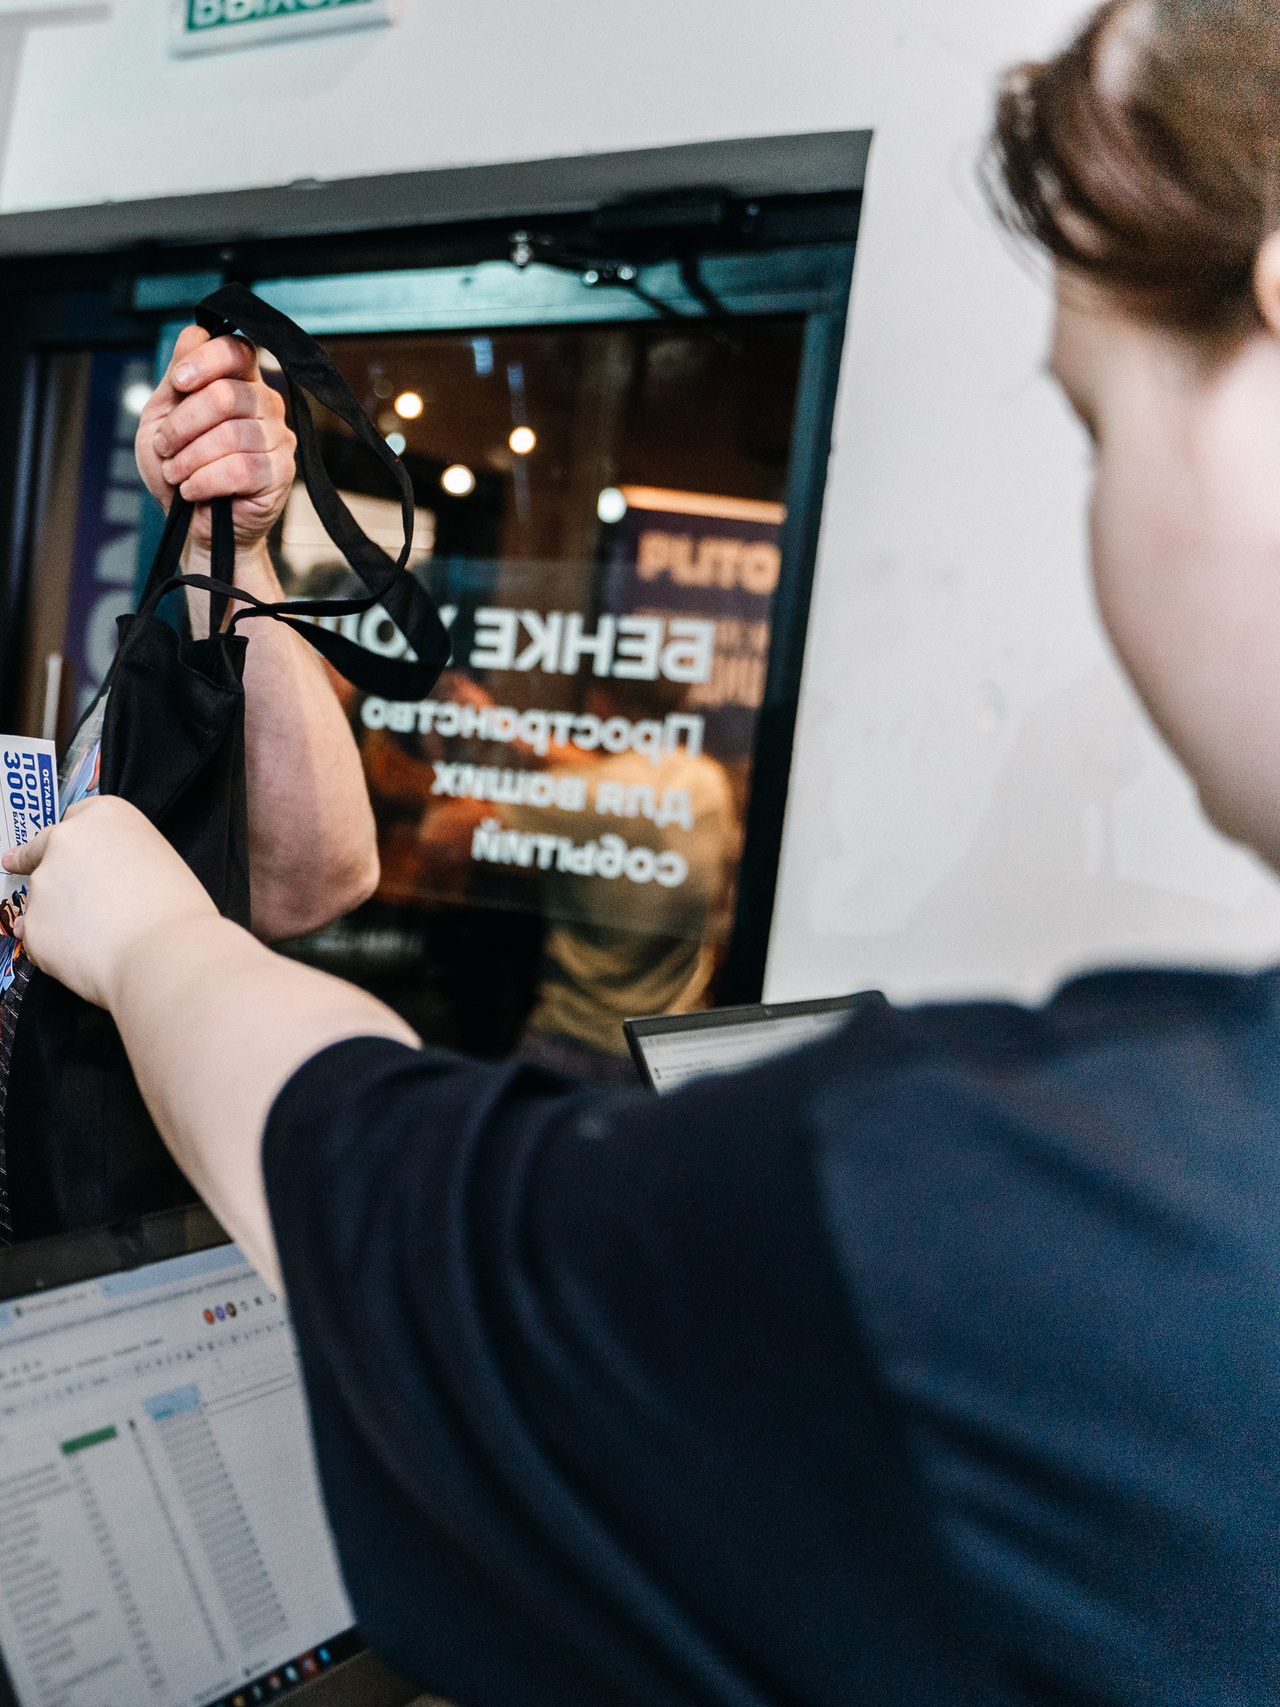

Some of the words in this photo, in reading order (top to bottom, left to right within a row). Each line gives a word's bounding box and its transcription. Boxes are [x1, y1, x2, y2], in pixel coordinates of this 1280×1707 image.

[636, 529, 782, 595] PLITO
[4, 751, 25, 810] 300
[22, 753, 41, 837] ПОЛУ
[43, 769, 51, 815] ОСТАВЬ
